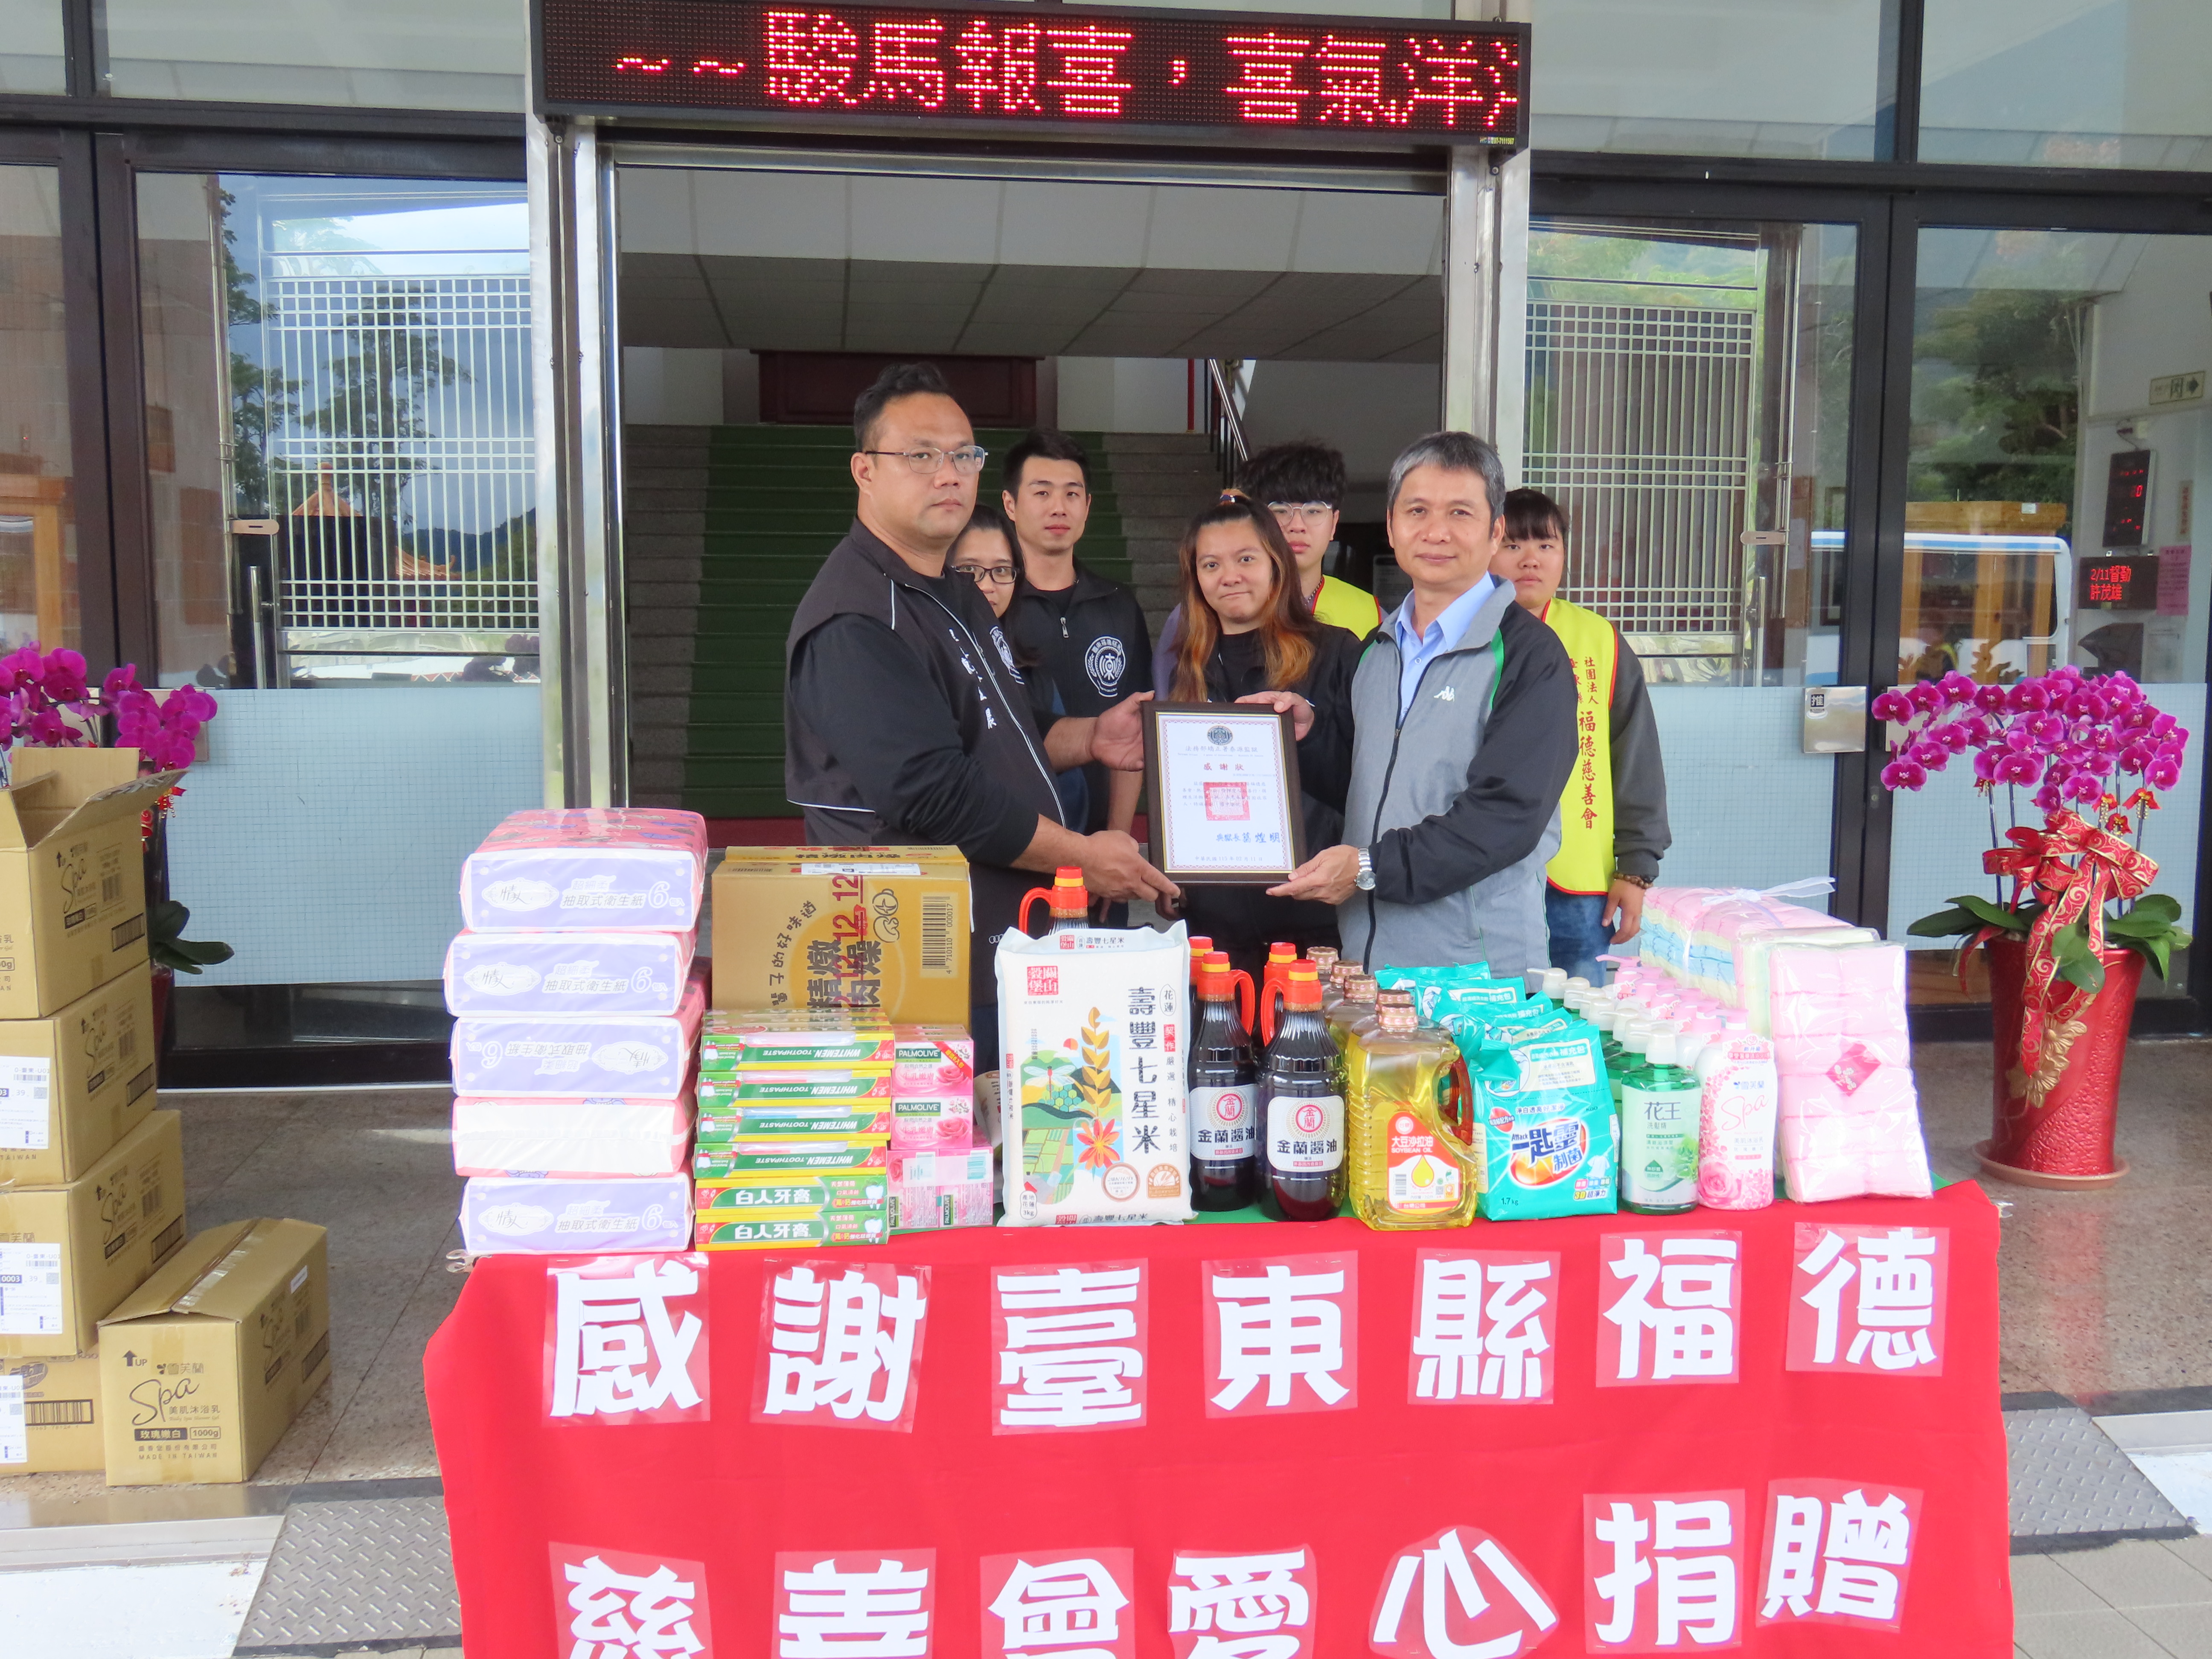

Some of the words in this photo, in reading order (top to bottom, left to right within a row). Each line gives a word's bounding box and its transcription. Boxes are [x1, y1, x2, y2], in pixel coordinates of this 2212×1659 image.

[1584, 657, 1599, 704] 社團法人
[1811, 695, 1824, 706] 推
[1579, 711, 1598, 830] 福德慈善會
[562, 895, 644, 906] 抽取式衛生紙
[545, 980, 627, 991] 抽取式衛生紙
[1164, 990, 1174, 1012] 花蓮
[1165, 1026, 1175, 1051] 契作
[814, 1049, 861, 1058] WHITEMEN
[1560, 1045, 1585, 1056] 補充包
[1127, 987, 1160, 1154] 壽豐七星米
[811, 1086, 858, 1094] WHITEMEN
[1224, 1096, 1236, 1117] 金蘭
[1644, 1102, 1682, 1121] 花王
[1721, 1094, 1769, 1131] Spa
[811, 1121, 858, 1130] WHITEMEN
[1302, 1108, 1317, 1129] 金蘭
[1198, 1126, 1255, 1143] 金蘭醬油
[1391, 1135, 1433, 1147] 大豆沙拉油
[1511, 1133, 1528, 1141] Attack
[1277, 1138, 1337, 1155] 金蘭醬油
[1512, 1121, 1579, 1167] 一匙靈
[806, 1155, 853, 1165] WHITEMEN
[1553, 1147, 1583, 1172] 制菌
[736, 1189, 810, 1205] 白人牙膏
[1574, 1191, 1586, 1199] 3D
[558, 1219, 638, 1231] 抽取式衛生紙
[735, 1223, 809, 1239] 白人牙膏
[549, 1226, 1939, 1428] 感謝臺東縣福德
[135, 1358, 148, 1366] UP
[129, 1378, 200, 1426] Spa
[169, 1405, 221, 1415] 美肌沐浴乳
[140, 1430, 181, 1439] 玫瑰嫩白
[192, 1429, 218, 1438] 1000g
